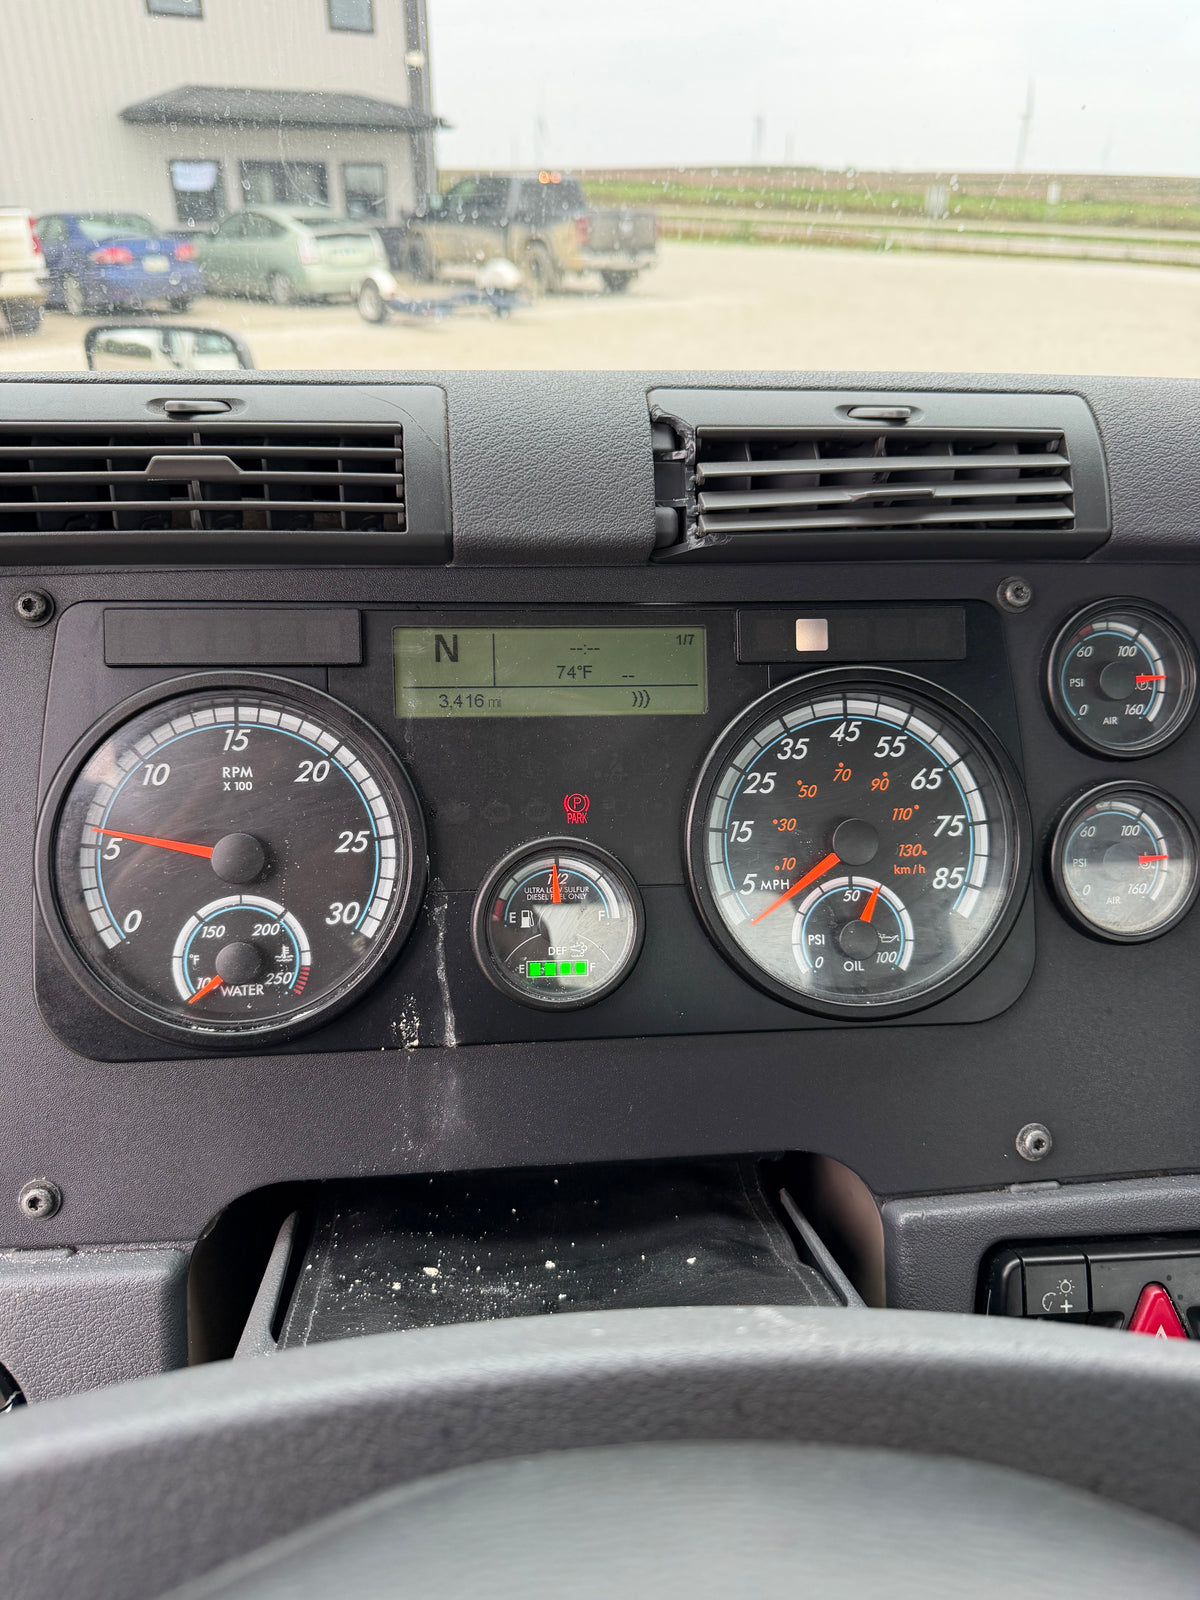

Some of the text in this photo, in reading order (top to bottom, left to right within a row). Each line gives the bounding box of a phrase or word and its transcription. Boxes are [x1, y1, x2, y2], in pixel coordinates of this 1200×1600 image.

[676, 634, 695, 645] 1/7
[435, 634, 458, 662] N
[1076, 646, 1092, 657] 60
[1118, 646, 1137, 656] 100
[556, 665, 592, 679] 74°F
[1070, 679, 1084, 687] PSI
[439, 694, 484, 710] 3,416
[1078, 704, 1088, 716] 0
[1124, 704, 1144, 715] 160
[1102, 717, 1118, 725] AIR
[829, 722, 861, 742] 45
[222, 730, 250, 751] 15
[874, 736, 906, 758] 55
[777, 738, 809, 760] 35
[142, 764, 170, 786] 10
[222, 766, 253, 778] RPM
[294, 761, 330, 783] 20
[832, 768, 852, 782] 70
[743, 772, 777, 794] 25
[870, 778, 890, 791] 90
[910, 768, 944, 790] 65
[224, 782, 253, 791] X 100
[798, 785, 817, 798] 50
[567, 812, 588, 824] PARK
[892, 808, 913, 821] 110
[777, 818, 796, 832] 30
[933, 815, 966, 837] 75
[1080, 826, 1096, 837] 60
[1121, 825, 1140, 836] 100
[729, 821, 754, 843] 15
[102, 838, 123, 860] 5
[334, 832, 370, 853] 25
[899, 844, 922, 857] 130
[780, 858, 796, 870] 10
[1072, 859, 1086, 868] PSI
[739, 874, 757, 896] 5
[760, 879, 790, 891] MPH
[932, 868, 964, 889] 85
[1082, 884, 1091, 896] 0
[1128, 884, 1147, 894] 160
[843, 890, 860, 902] 50
[325, 902, 360, 924] 30
[510, 912, 516, 923] E
[598, 911, 605, 922] F
[124, 910, 142, 933] 0
[202, 926, 226, 938] 150
[252, 923, 280, 936] 200
[808, 934, 825, 946] PSI
[548, 947, 567, 956] DEF
[876, 951, 897, 964] 100
[519, 964, 525, 974] E
[590, 964, 596, 972] F
[814, 956, 824, 969] 0
[844, 960, 864, 972] OIL
[264, 972, 293, 985] 250
[220, 984, 265, 996] WATER
